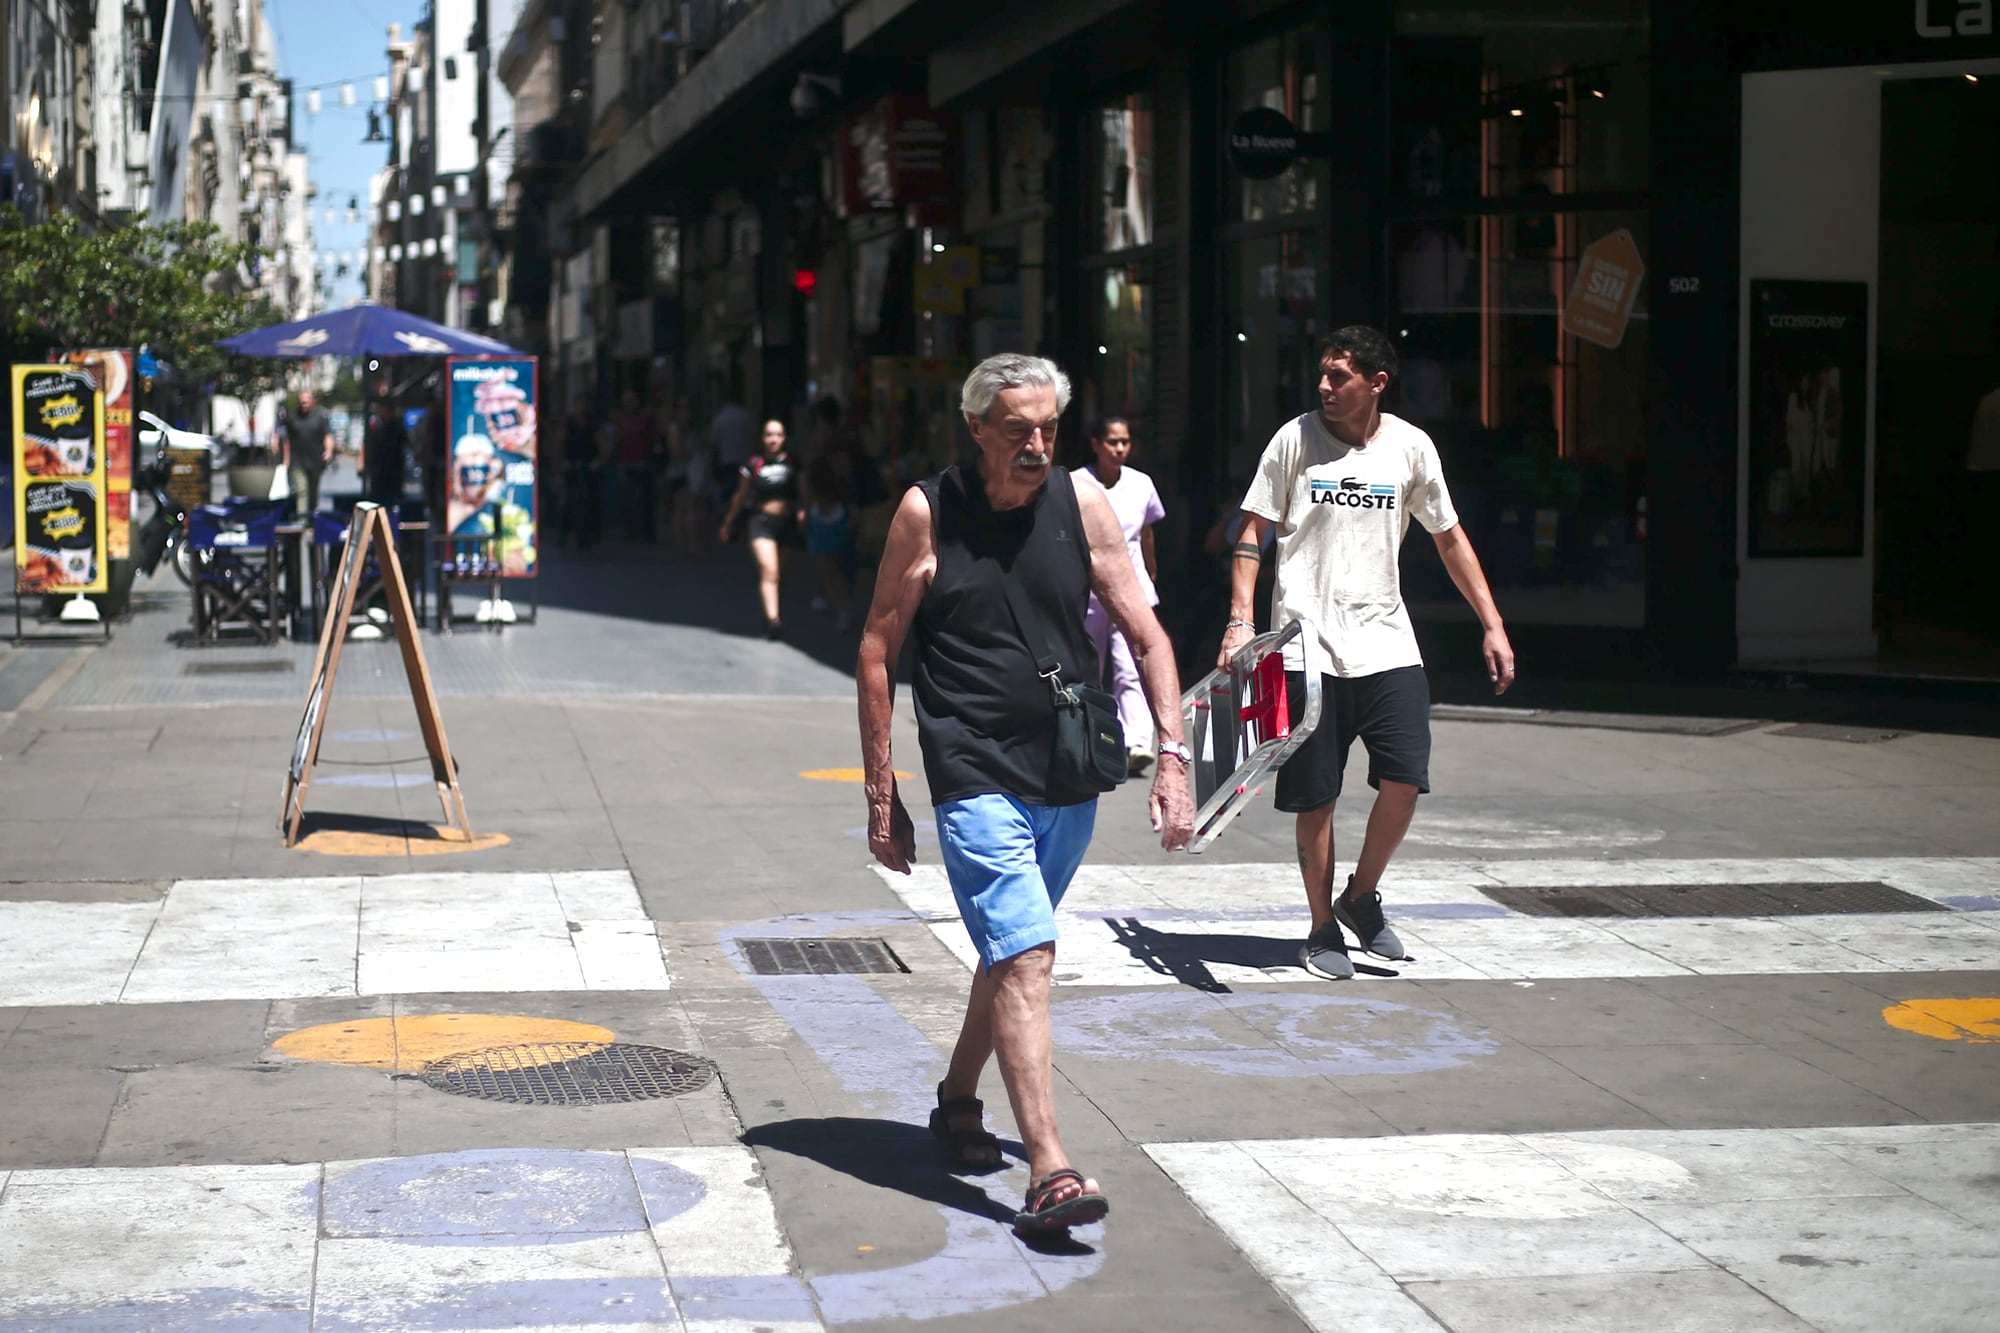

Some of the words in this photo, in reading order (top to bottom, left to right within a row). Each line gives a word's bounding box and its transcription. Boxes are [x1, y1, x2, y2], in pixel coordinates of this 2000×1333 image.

[1916, 0, 1993, 38] La
[1587, 270, 1626, 302] SIN
[1669, 276, 1700, 293] 502
[1768, 313, 1847, 329] crossover
[1311, 490, 1395, 510] LACOSTE
